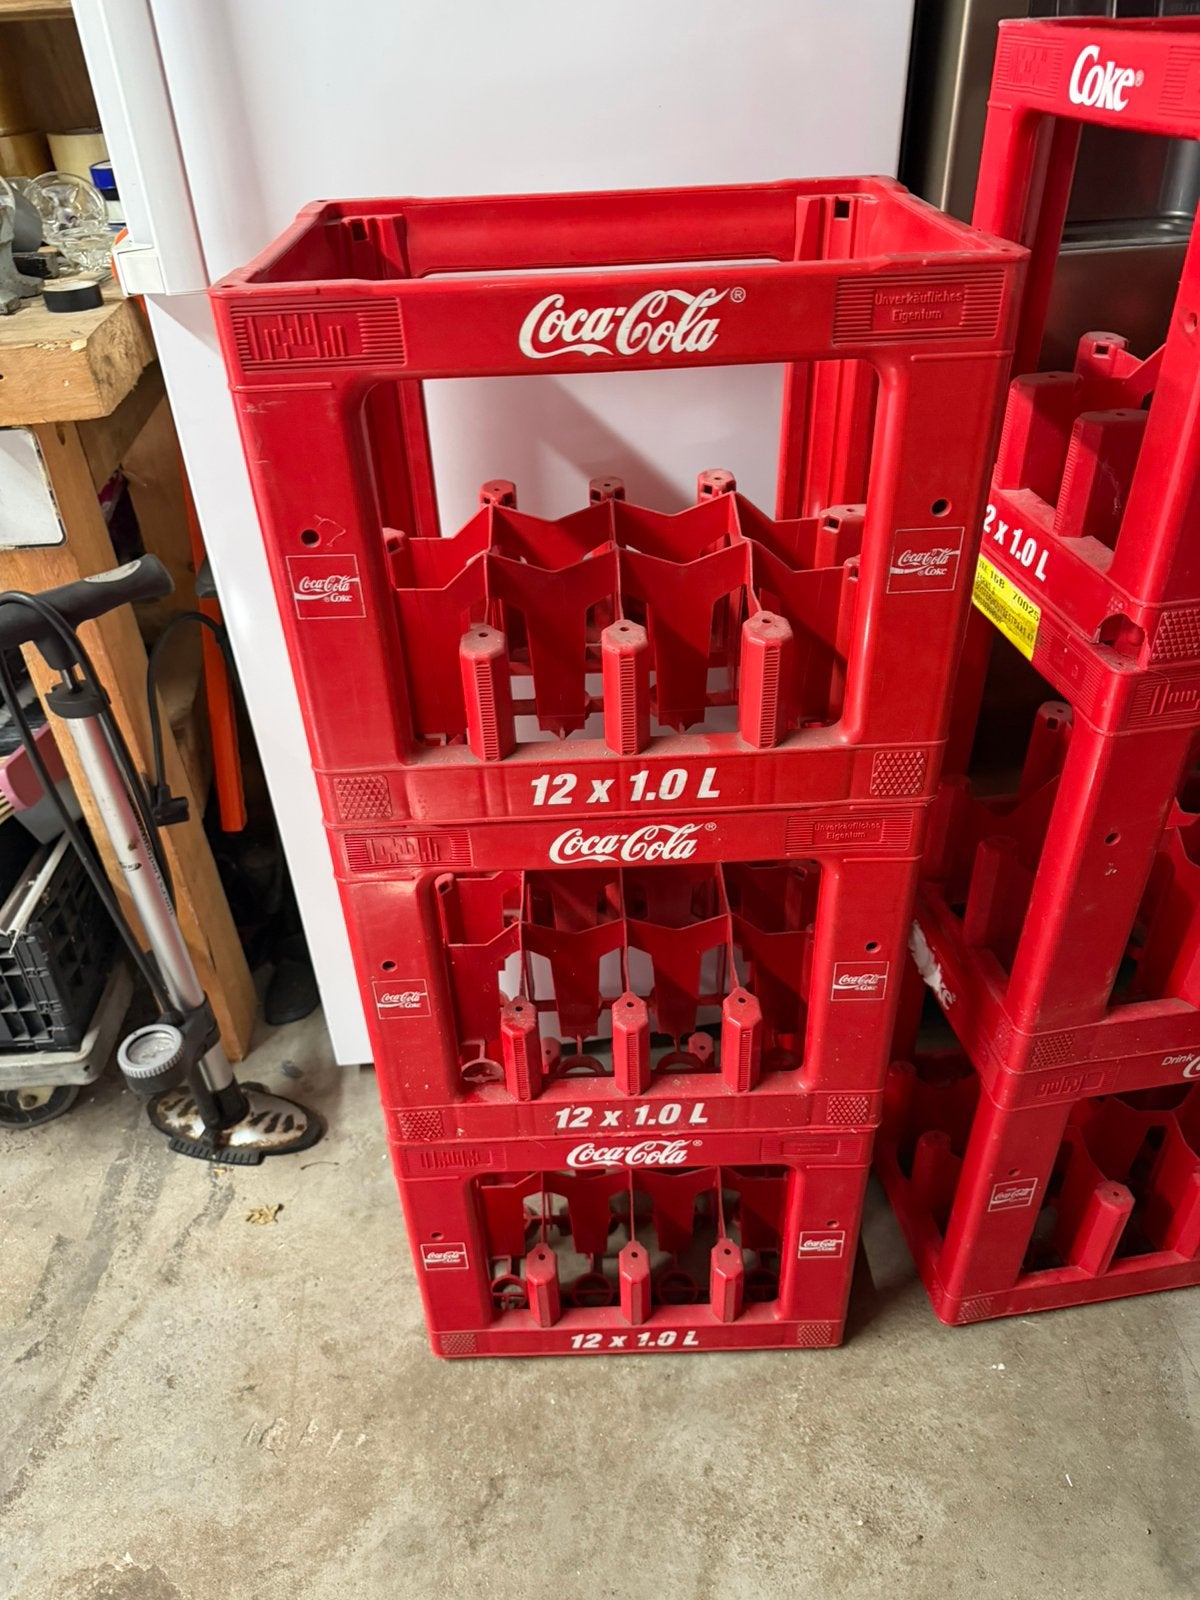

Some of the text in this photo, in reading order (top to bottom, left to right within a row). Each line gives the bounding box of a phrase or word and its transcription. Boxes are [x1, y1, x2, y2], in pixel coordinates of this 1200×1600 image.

[1069, 45, 1135, 111] Coke
[518, 288, 730, 359] Coca-Cola
[892, 308, 942, 323] Eigentum
[983, 504, 1049, 582] 2 x 1.0 L
[531, 767, 720, 806] 12 x 1.0 L
[549, 823, 703, 864] Coca-Cola
[1161, 1053, 1195, 1066] Drink
[555, 1103, 708, 1129] 12 x 1.0 L
[566, 1139, 691, 1167] Coca-Cola
[571, 1330, 699, 1349] 12 x 1.0 L
